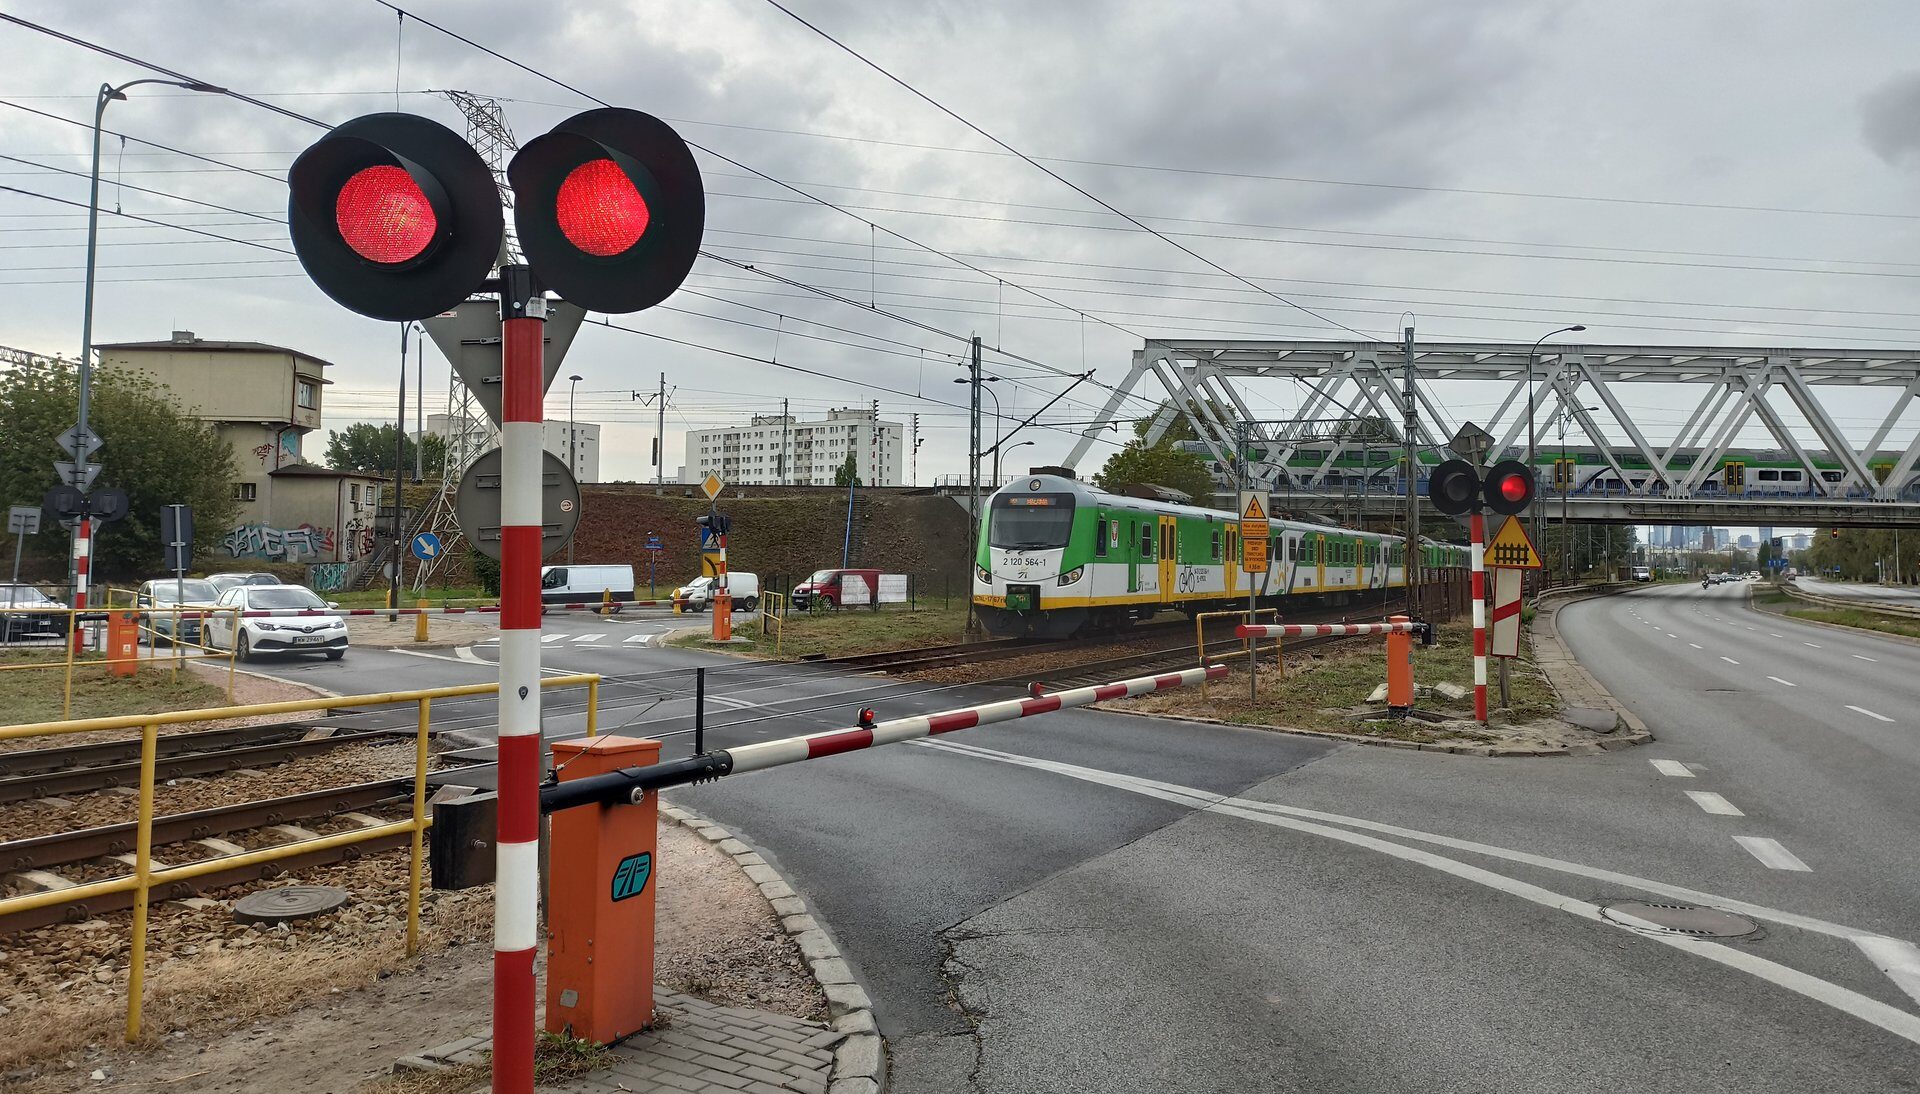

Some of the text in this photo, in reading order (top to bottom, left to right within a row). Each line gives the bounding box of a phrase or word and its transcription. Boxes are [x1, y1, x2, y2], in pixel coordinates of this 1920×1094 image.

[1003, 558, 1046, 567] 2 120 564-1
